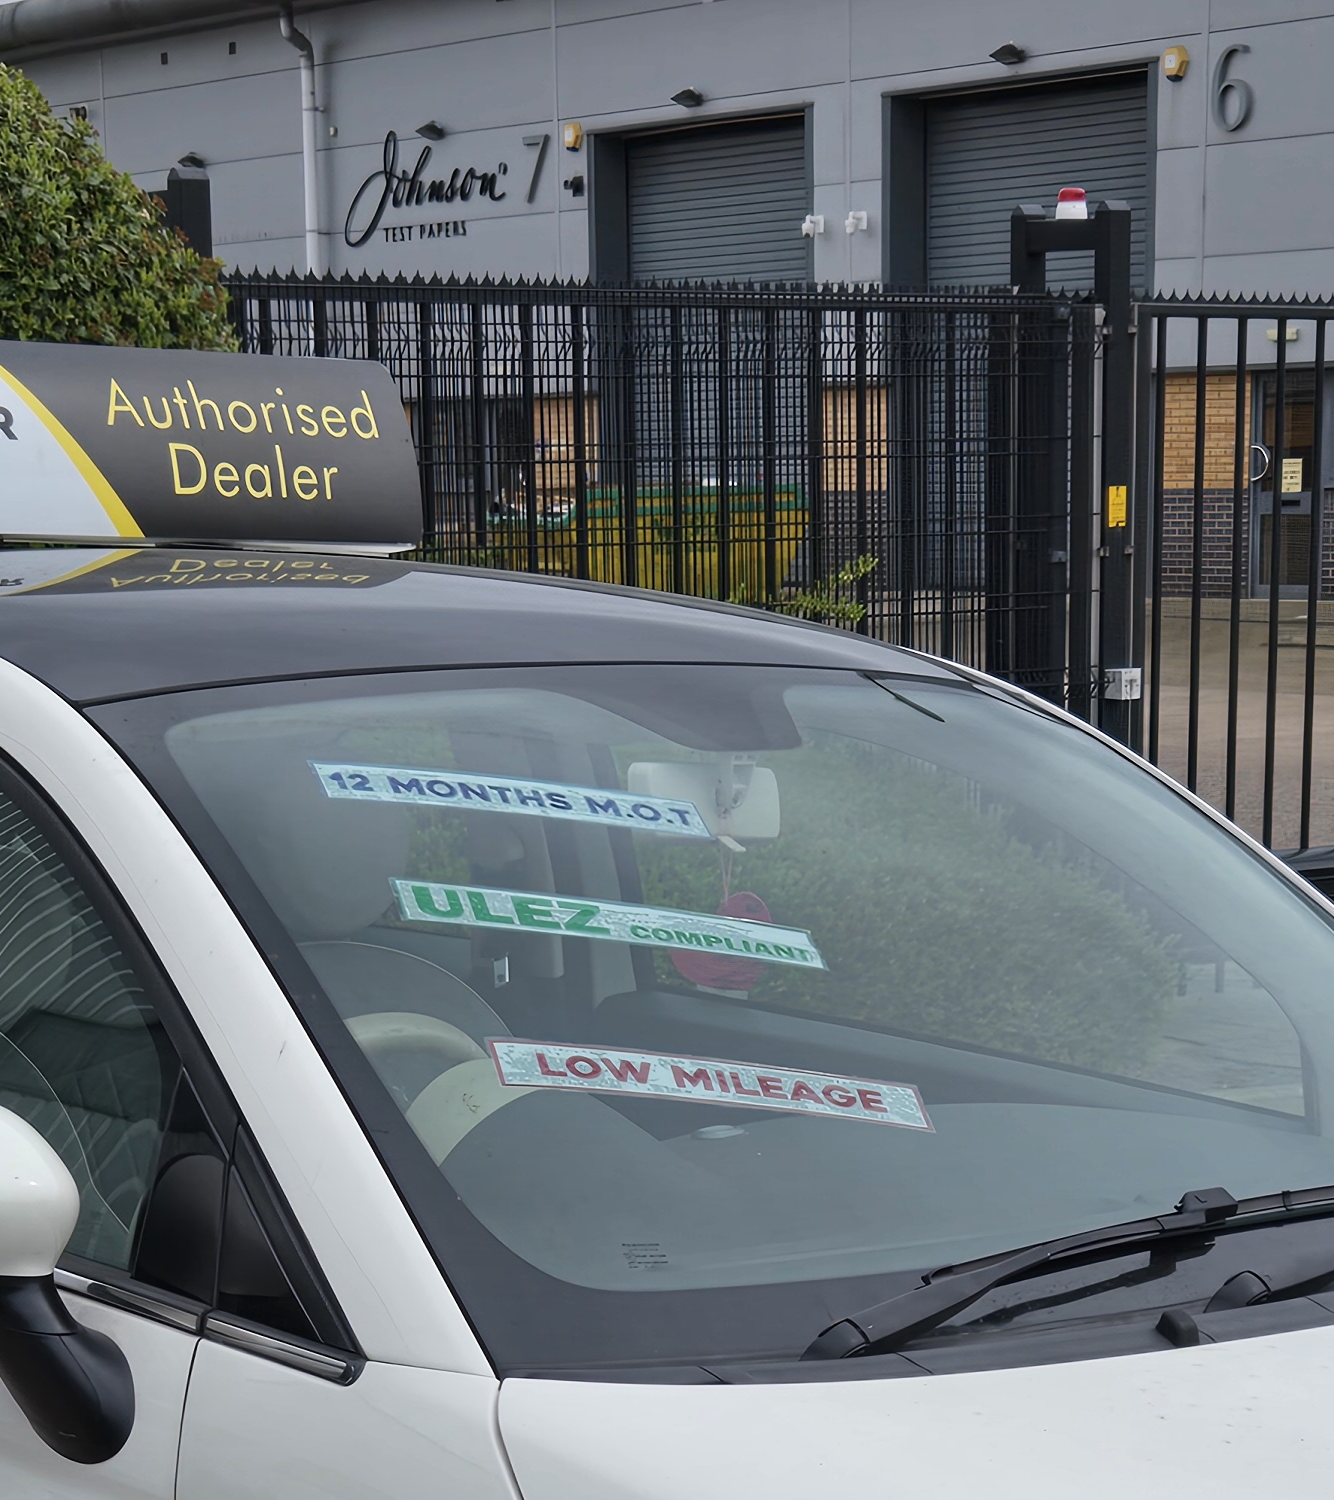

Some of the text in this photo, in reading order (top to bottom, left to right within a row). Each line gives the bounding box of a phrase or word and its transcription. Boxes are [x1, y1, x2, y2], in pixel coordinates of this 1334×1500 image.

[1211, 44, 1255, 132] 6
[522, 133, 550, 204] 7
[383, 220, 467, 243] TEST PAPERS
[107, 378, 380, 440] Authorised
[168, 443, 339, 500] Dealer
[329, 771, 691, 827] 12 MONTHS M.O.T
[411, 884, 815, 963] ULEZ COMPLIANT
[535, 1052, 889, 1114] LOW MILEAGE
